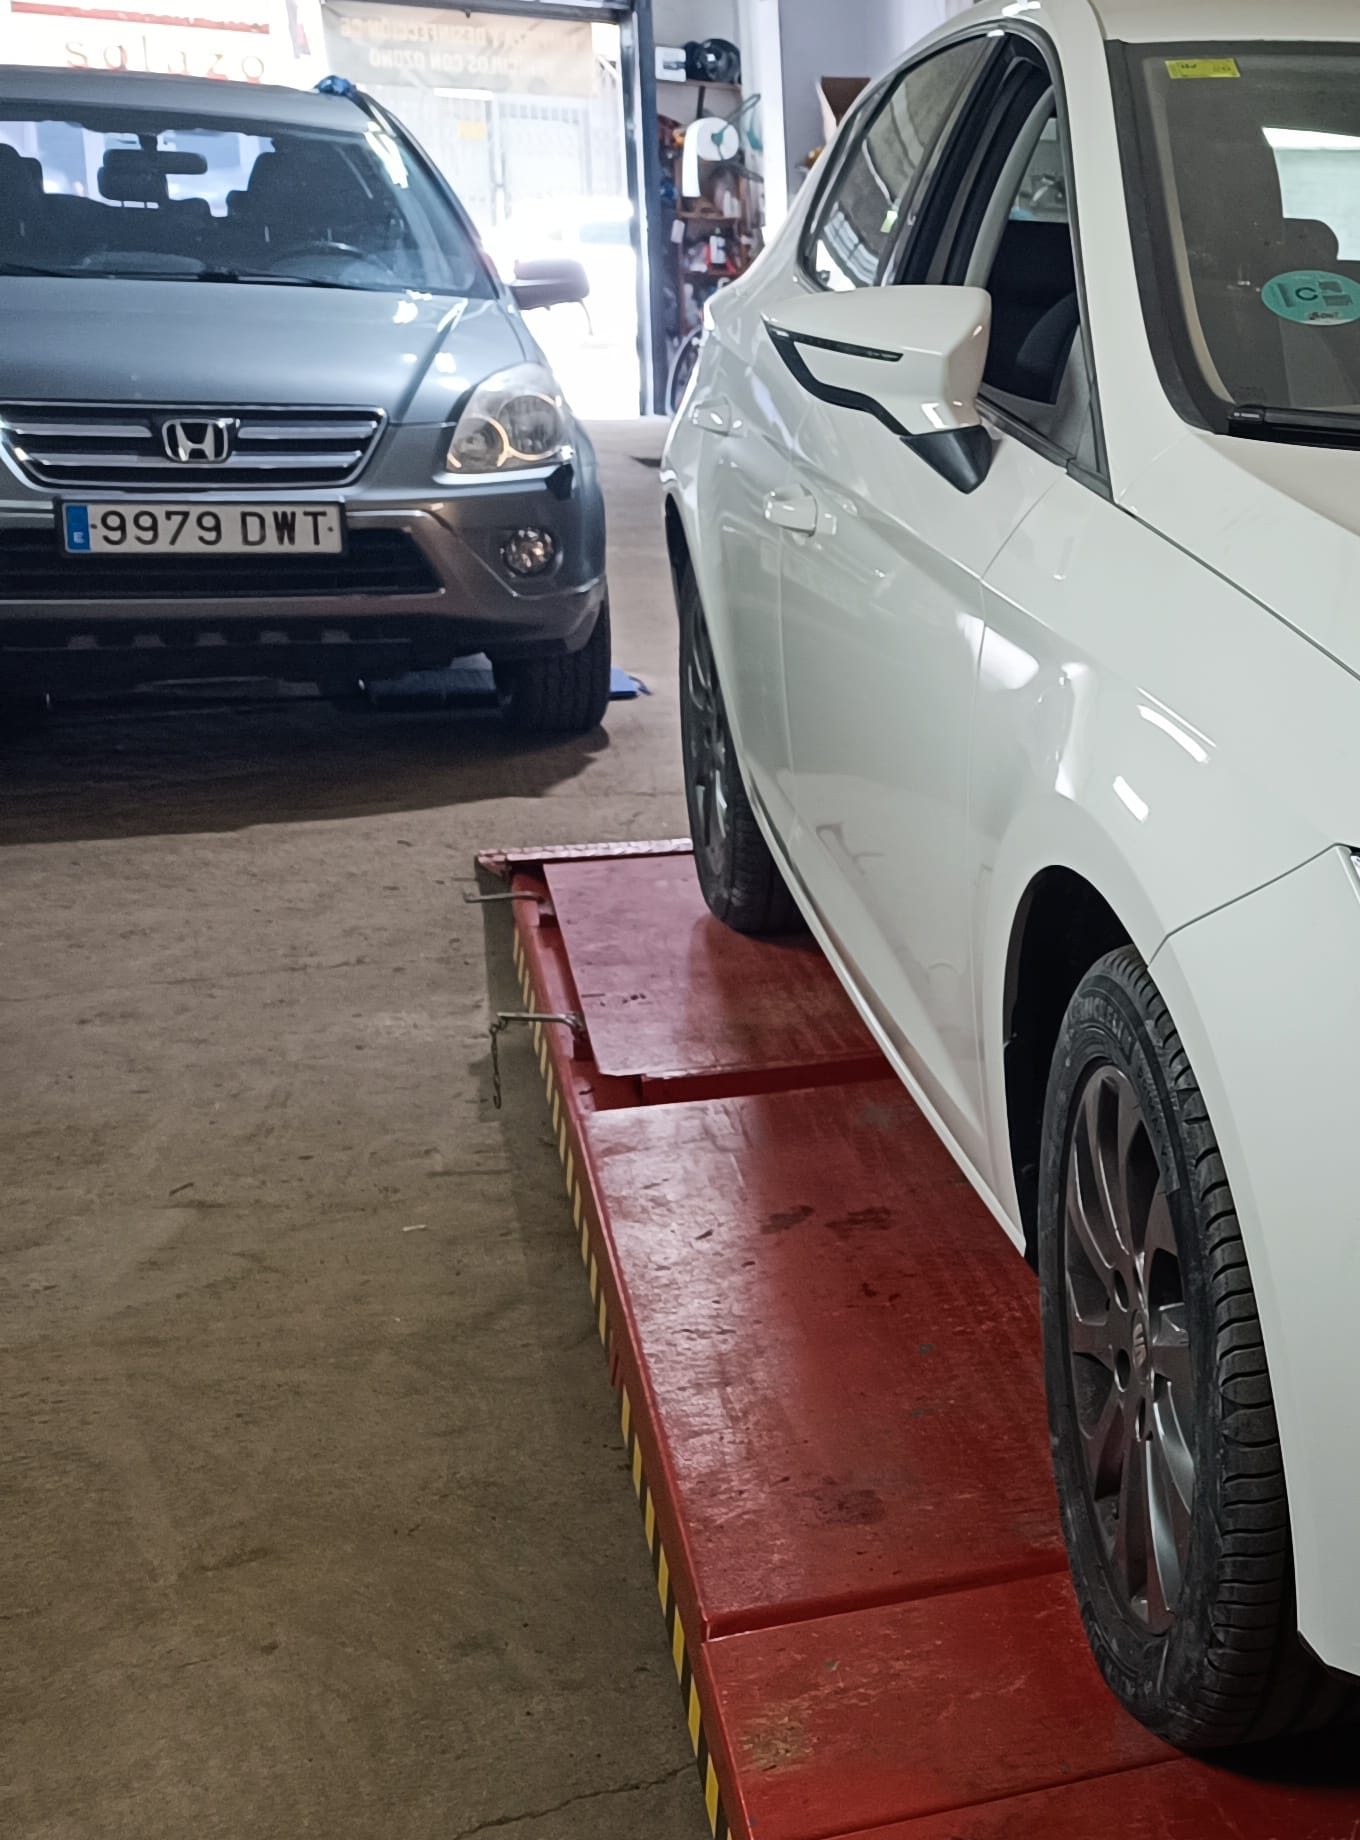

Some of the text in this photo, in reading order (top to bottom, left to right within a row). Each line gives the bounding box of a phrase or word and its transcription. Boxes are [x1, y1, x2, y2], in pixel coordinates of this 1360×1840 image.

[1295, 287, 1318, 301] C
[100, 510, 327, 546] 9979 DWT
